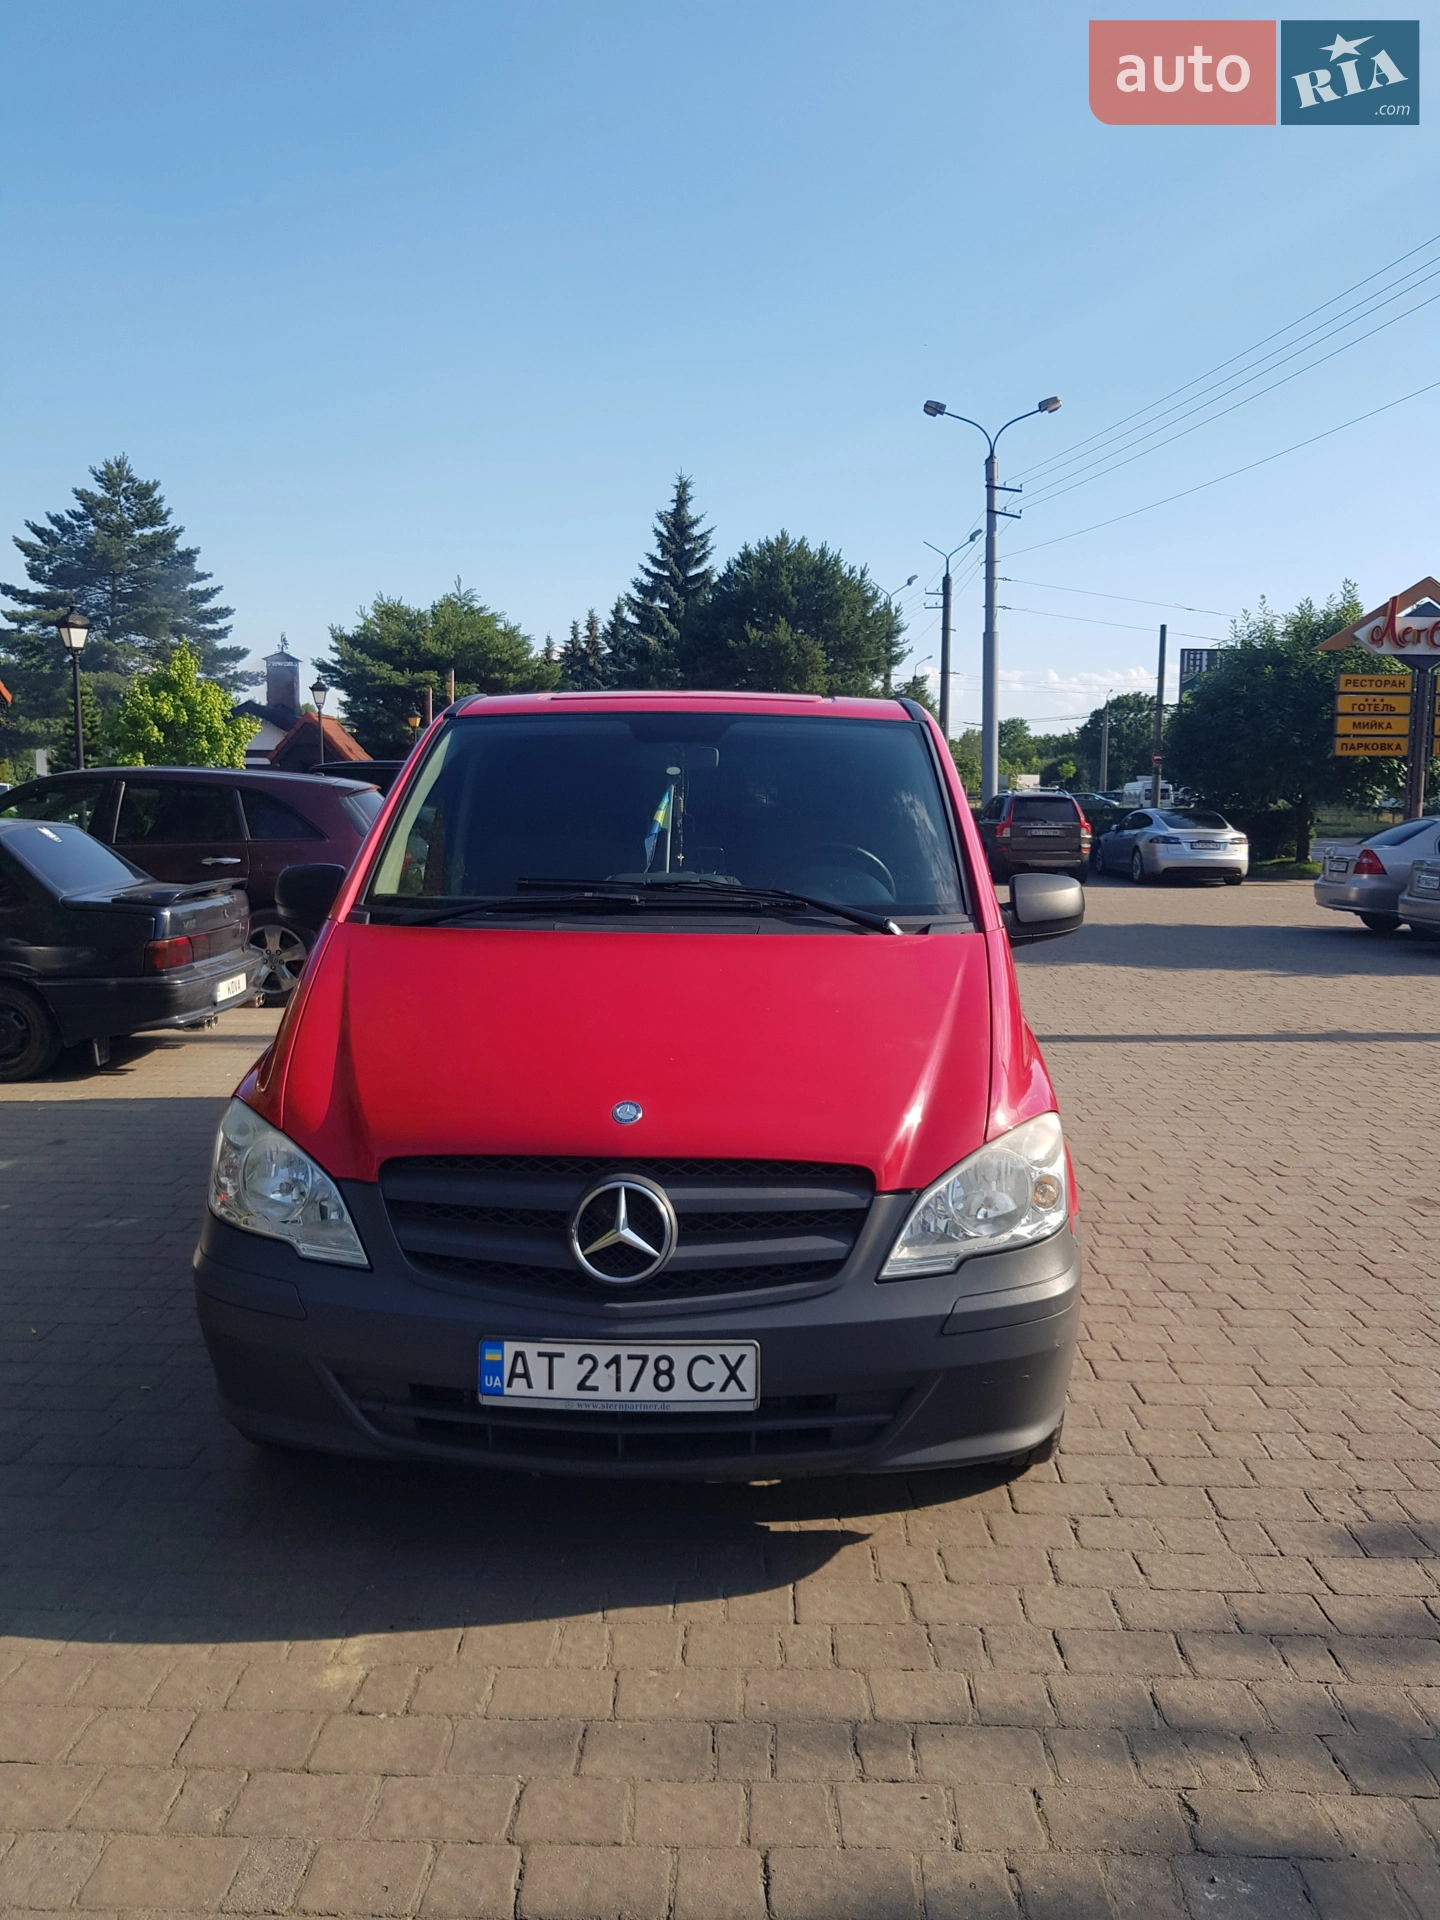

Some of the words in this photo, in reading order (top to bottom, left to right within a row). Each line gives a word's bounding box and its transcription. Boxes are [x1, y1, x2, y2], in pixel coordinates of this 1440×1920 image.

[1344, 678, 1406, 688] РЕСТОРАН
[1351, 703, 1396, 712] ГОТЕЛЬ
[1352, 720, 1393, 730] МИЙКА
[1340, 742, 1402, 752] ПАРКОВКА
[506, 1350, 565, 1390] AT
[576, 1353, 676, 1393] 2178
[687, 1353, 748, 1393] CX
[485, 1375, 501, 1387] UA
[576, 1402, 671, 1411] www.sternpartner.de
